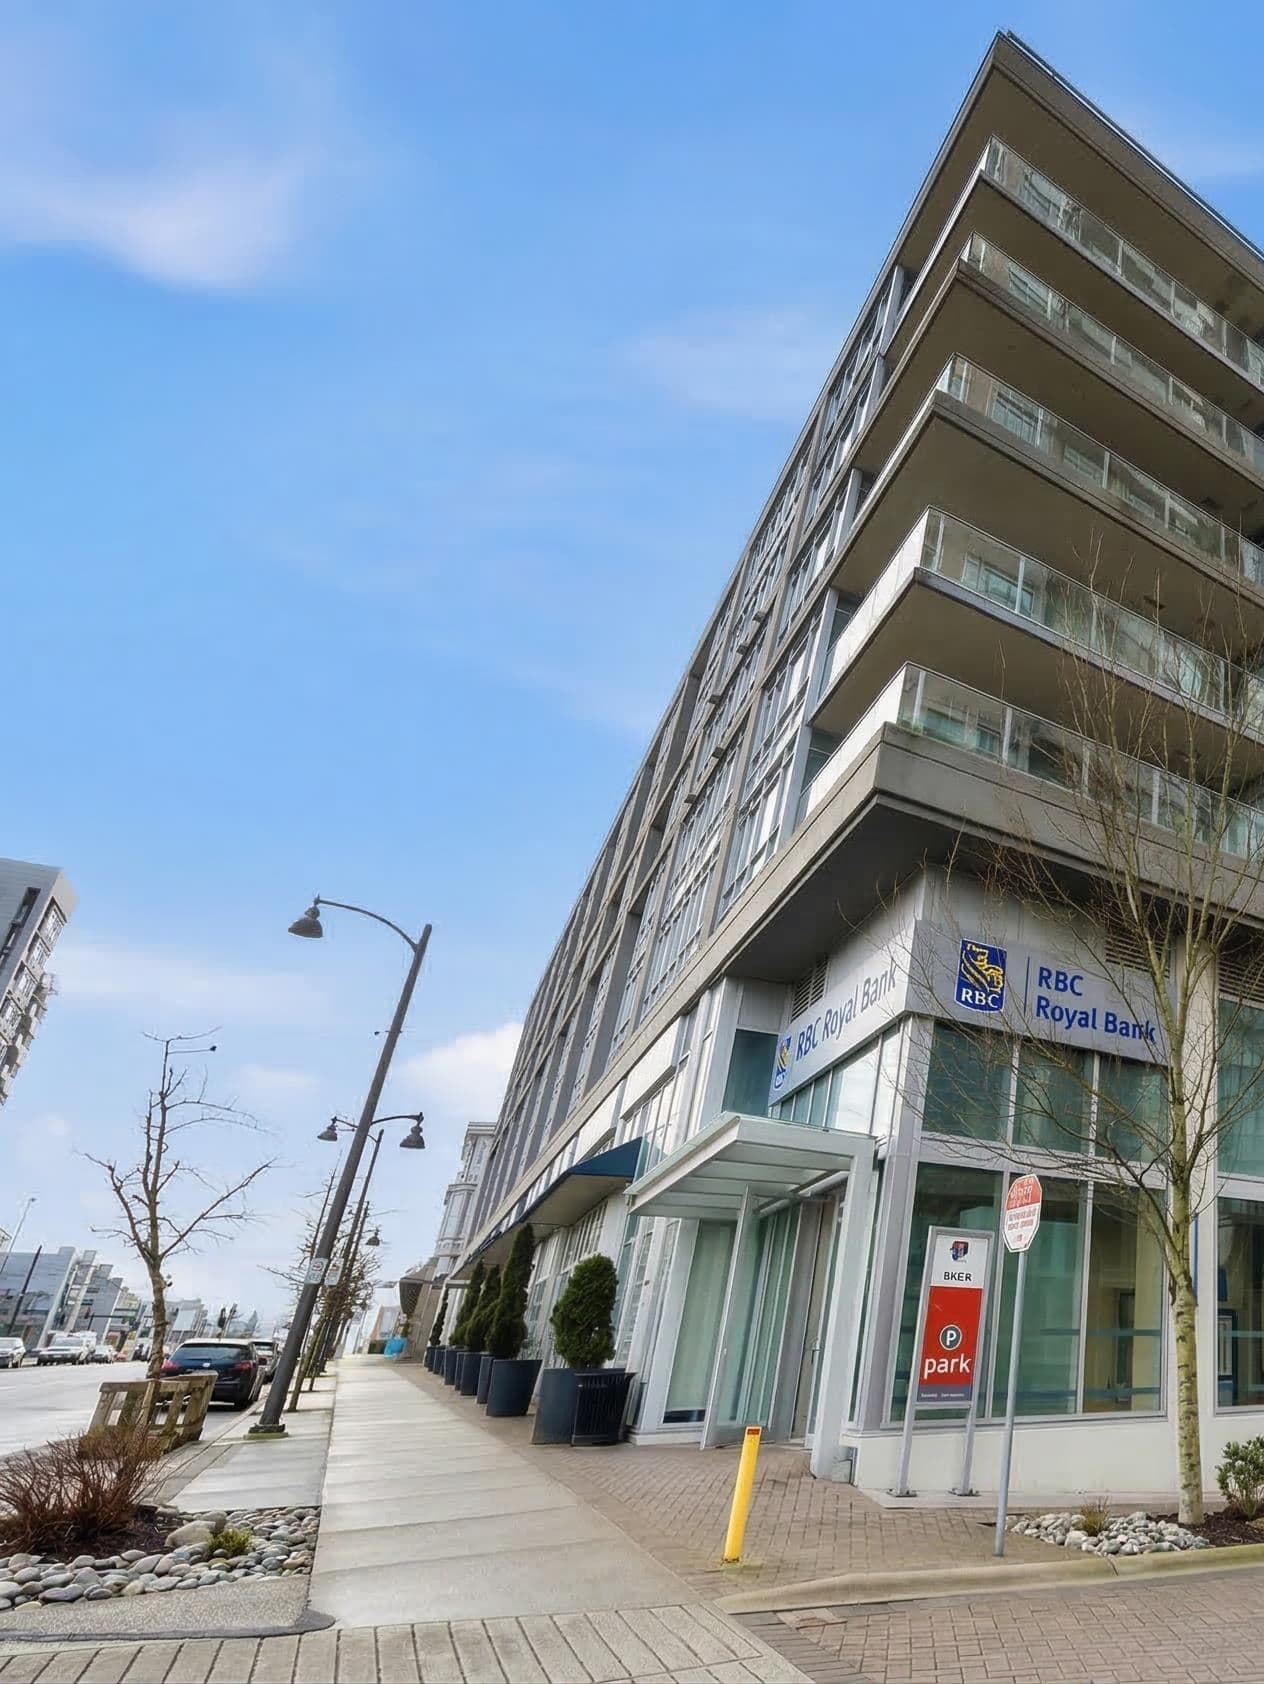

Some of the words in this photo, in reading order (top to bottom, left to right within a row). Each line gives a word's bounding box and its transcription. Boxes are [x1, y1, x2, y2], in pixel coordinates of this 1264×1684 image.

[1038, 966, 1084, 998] RBC
[796, 1017, 821, 1061] RBC
[822, 984, 858, 1042] Royal
[860, 960, 897, 1014] Bank
[961, 986, 1001, 1010] RBC
[1036, 996, 1098, 1032] Royal
[1103, 1012, 1158, 1045] Bank
[943, 1271, 972, 1282] BKER
[946, 1330, 957, 1346] P
[923, 1353, 972, 1380] park
